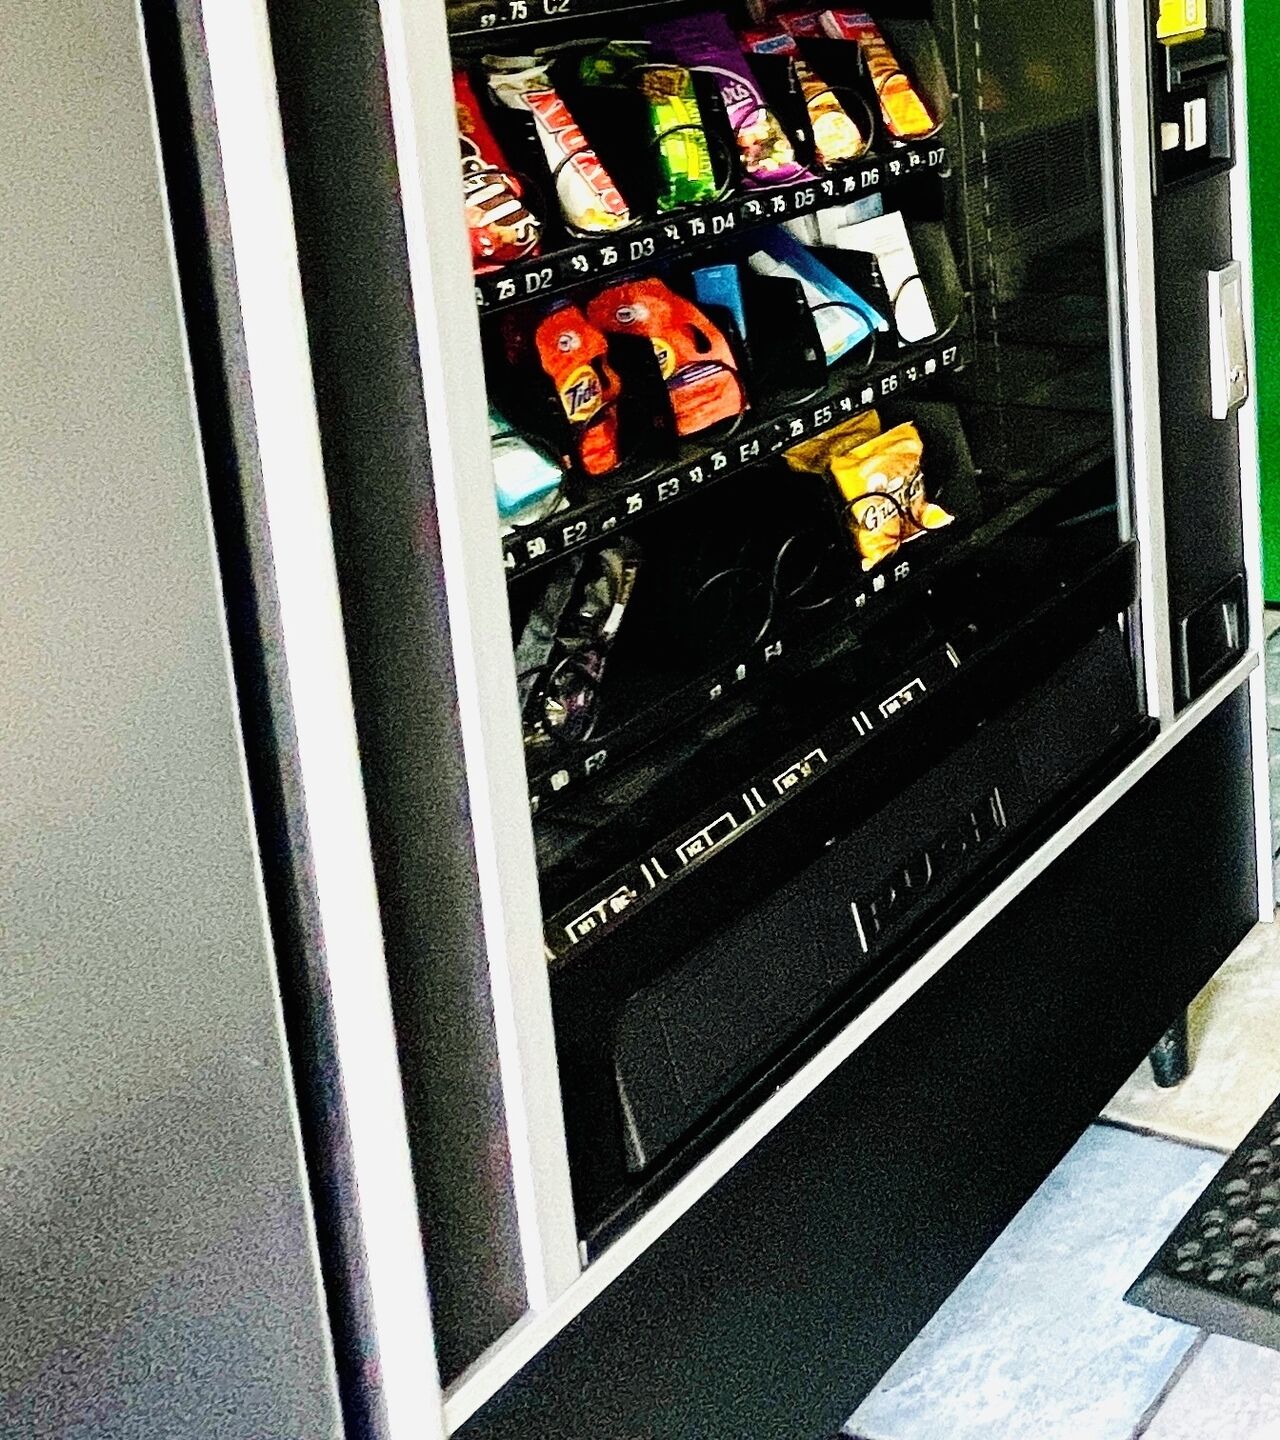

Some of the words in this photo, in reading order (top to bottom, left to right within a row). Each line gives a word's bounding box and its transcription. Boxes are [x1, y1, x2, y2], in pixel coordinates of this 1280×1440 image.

[928, 147, 946, 167] D7
[861, 168, 880, 189] D6
[794, 187, 815, 209] D5
[712, 212, 735, 235] D4
[630, 237, 655, 261] D3
[525, 268, 553, 294] D2
[942, 346, 957, 366] E7
[881, 374, 898, 396] E6
[814, 405, 833, 428] E5
[739, 439, 760, 463] E4
[657, 477, 680, 502] E3
[562, 521, 588, 547] E2
[893, 561, 911, 582] F6
